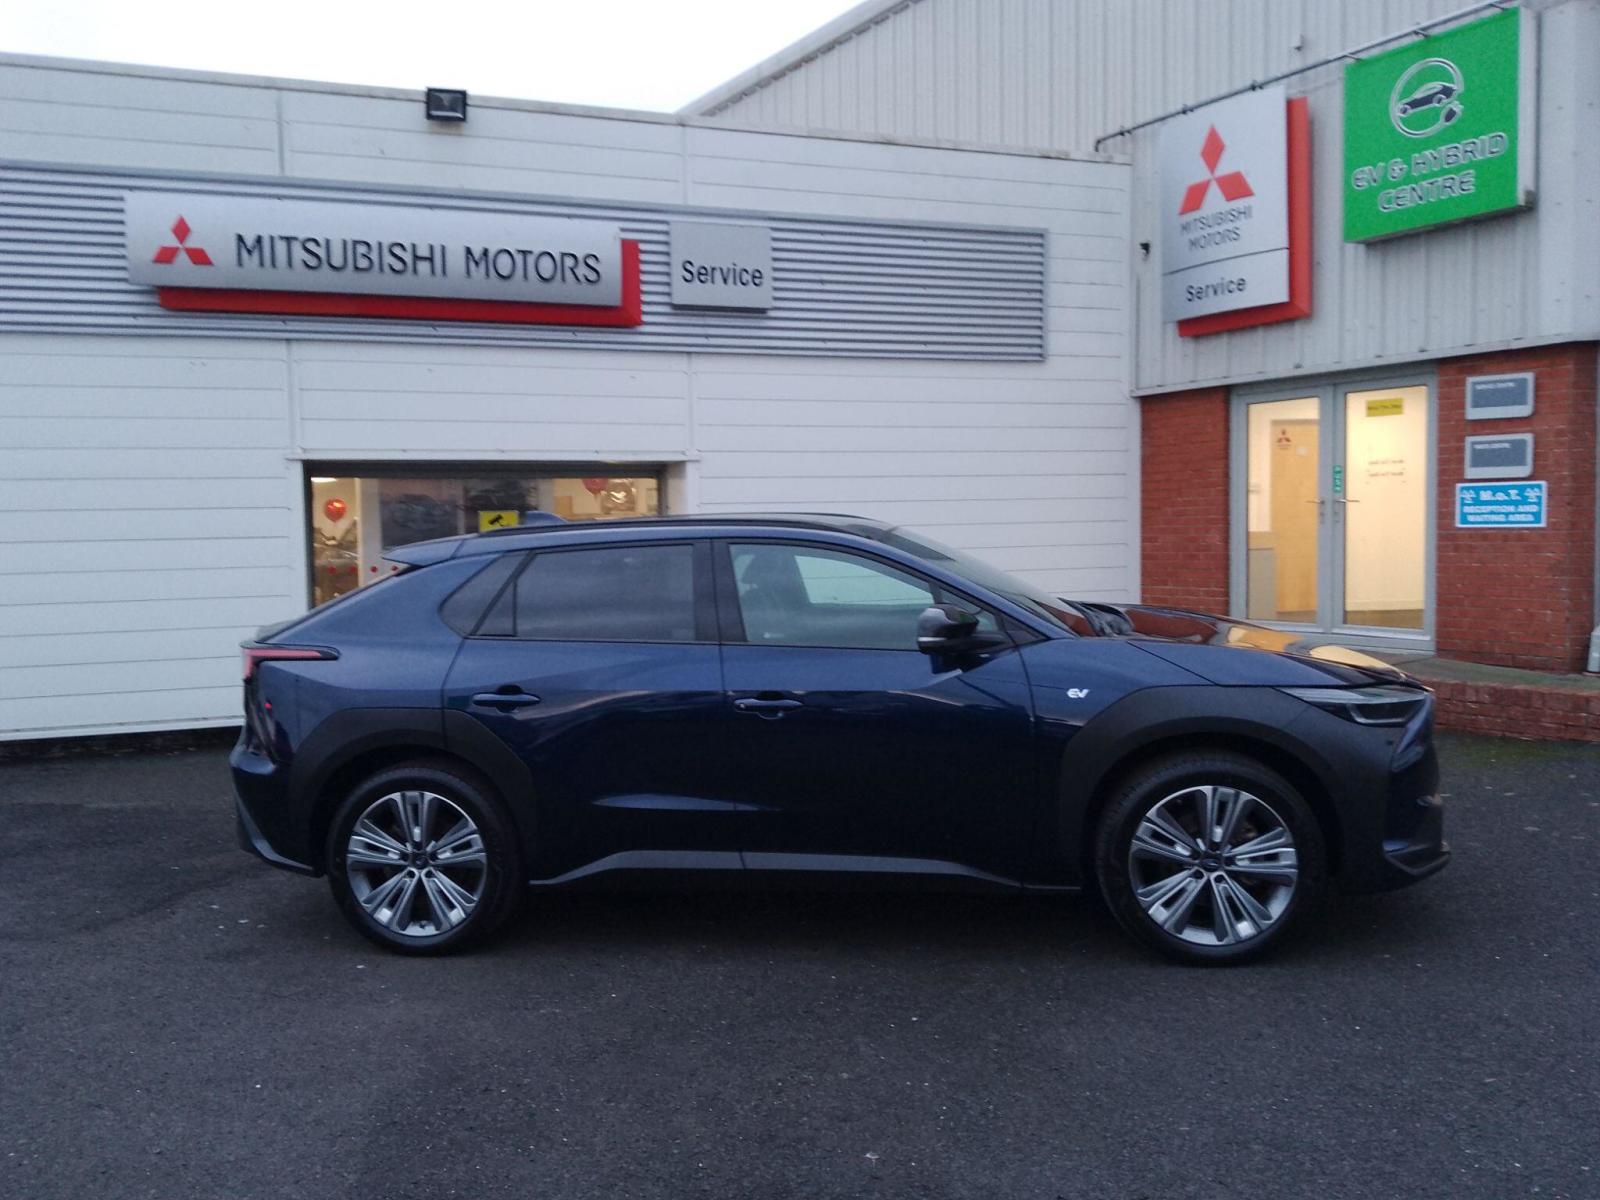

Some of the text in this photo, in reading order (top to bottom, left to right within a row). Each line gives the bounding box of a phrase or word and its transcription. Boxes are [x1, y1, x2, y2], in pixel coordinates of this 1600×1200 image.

[1352, 132, 1508, 190] EV & HYBRID
[1378, 170, 1476, 212] CENTRE
[1179, 205, 1253, 235] MITSUBISHI
[1188, 226, 1241, 250] MOTORS
[235, 233, 602, 284] MITSUBISHI MOTORS
[681, 259, 764, 287] Service
[1185, 276, 1247, 302] Service
[1066, 688, 1090, 698] EV
